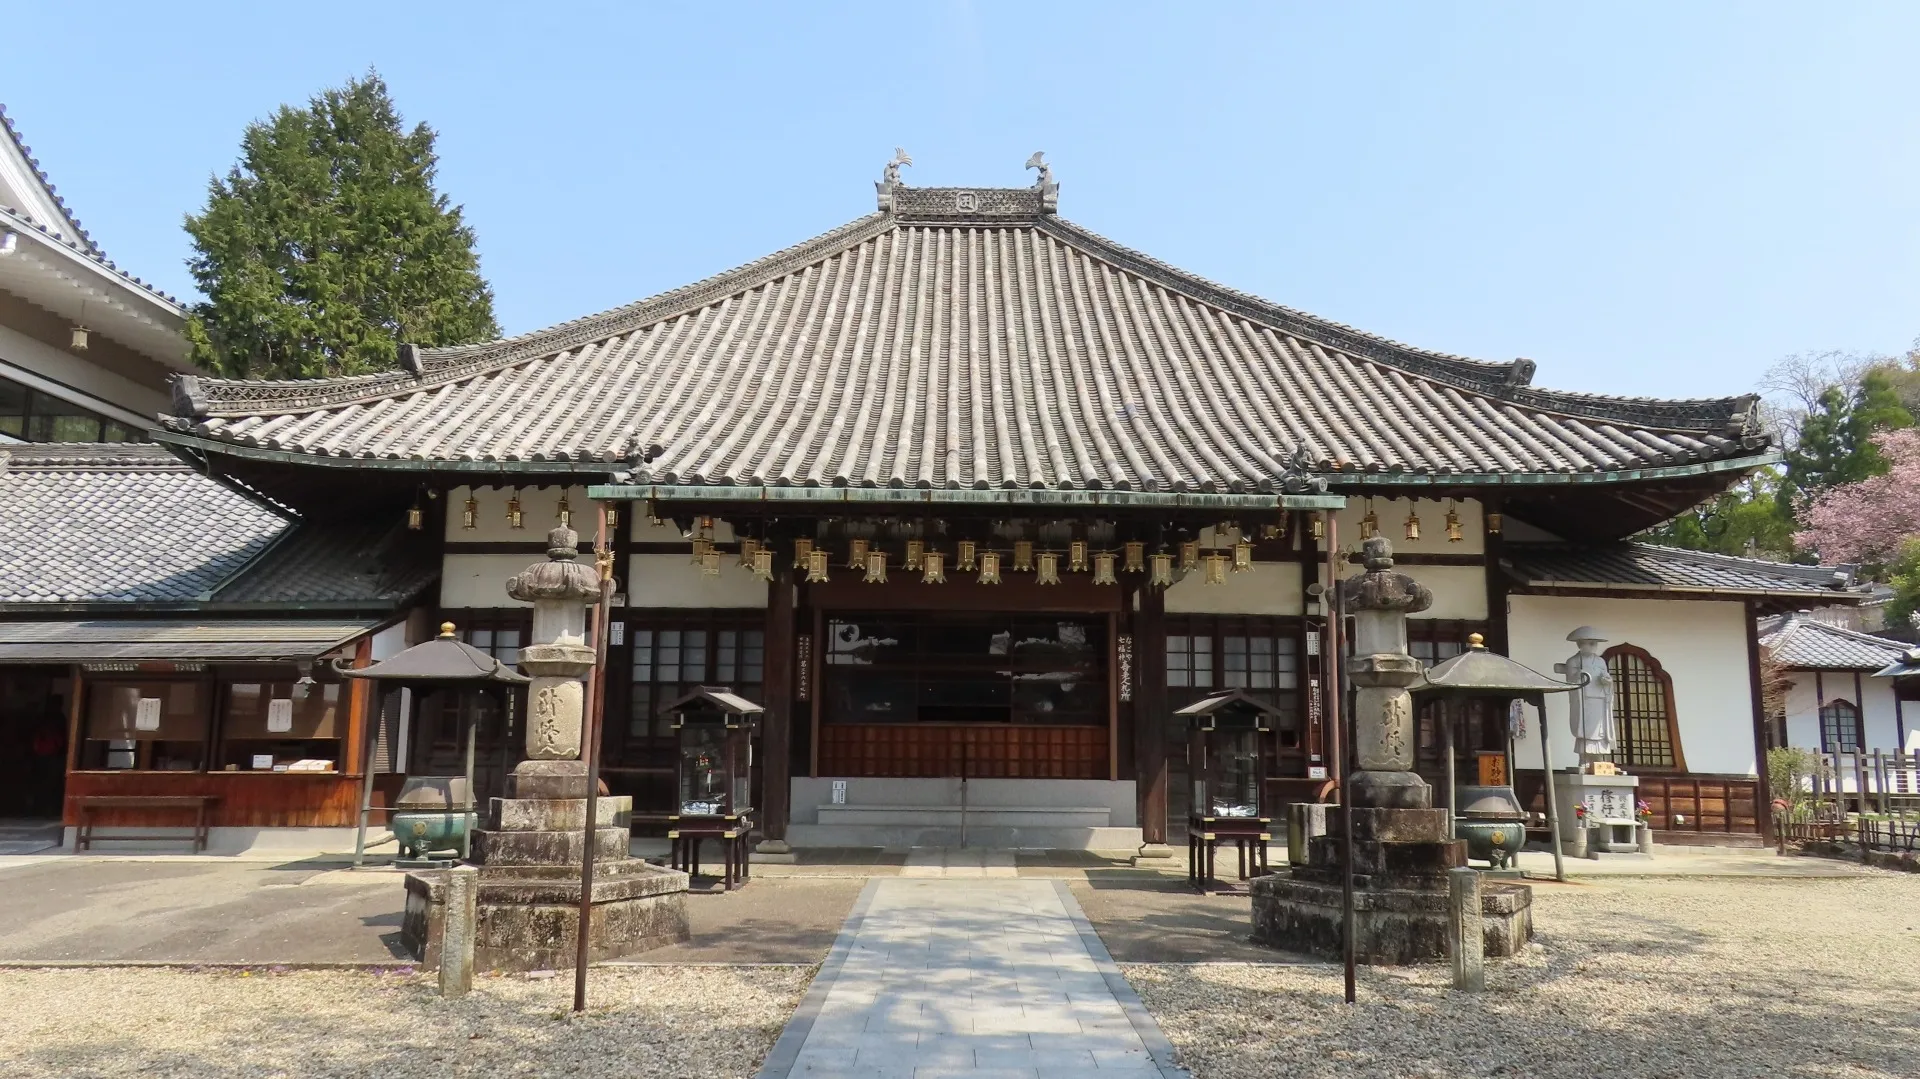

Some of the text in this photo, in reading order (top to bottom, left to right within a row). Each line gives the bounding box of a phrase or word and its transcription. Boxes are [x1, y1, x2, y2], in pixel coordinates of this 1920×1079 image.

[1118, 636, 1126, 661] 七福神
[1601, 789, 1615, 818] 修行
